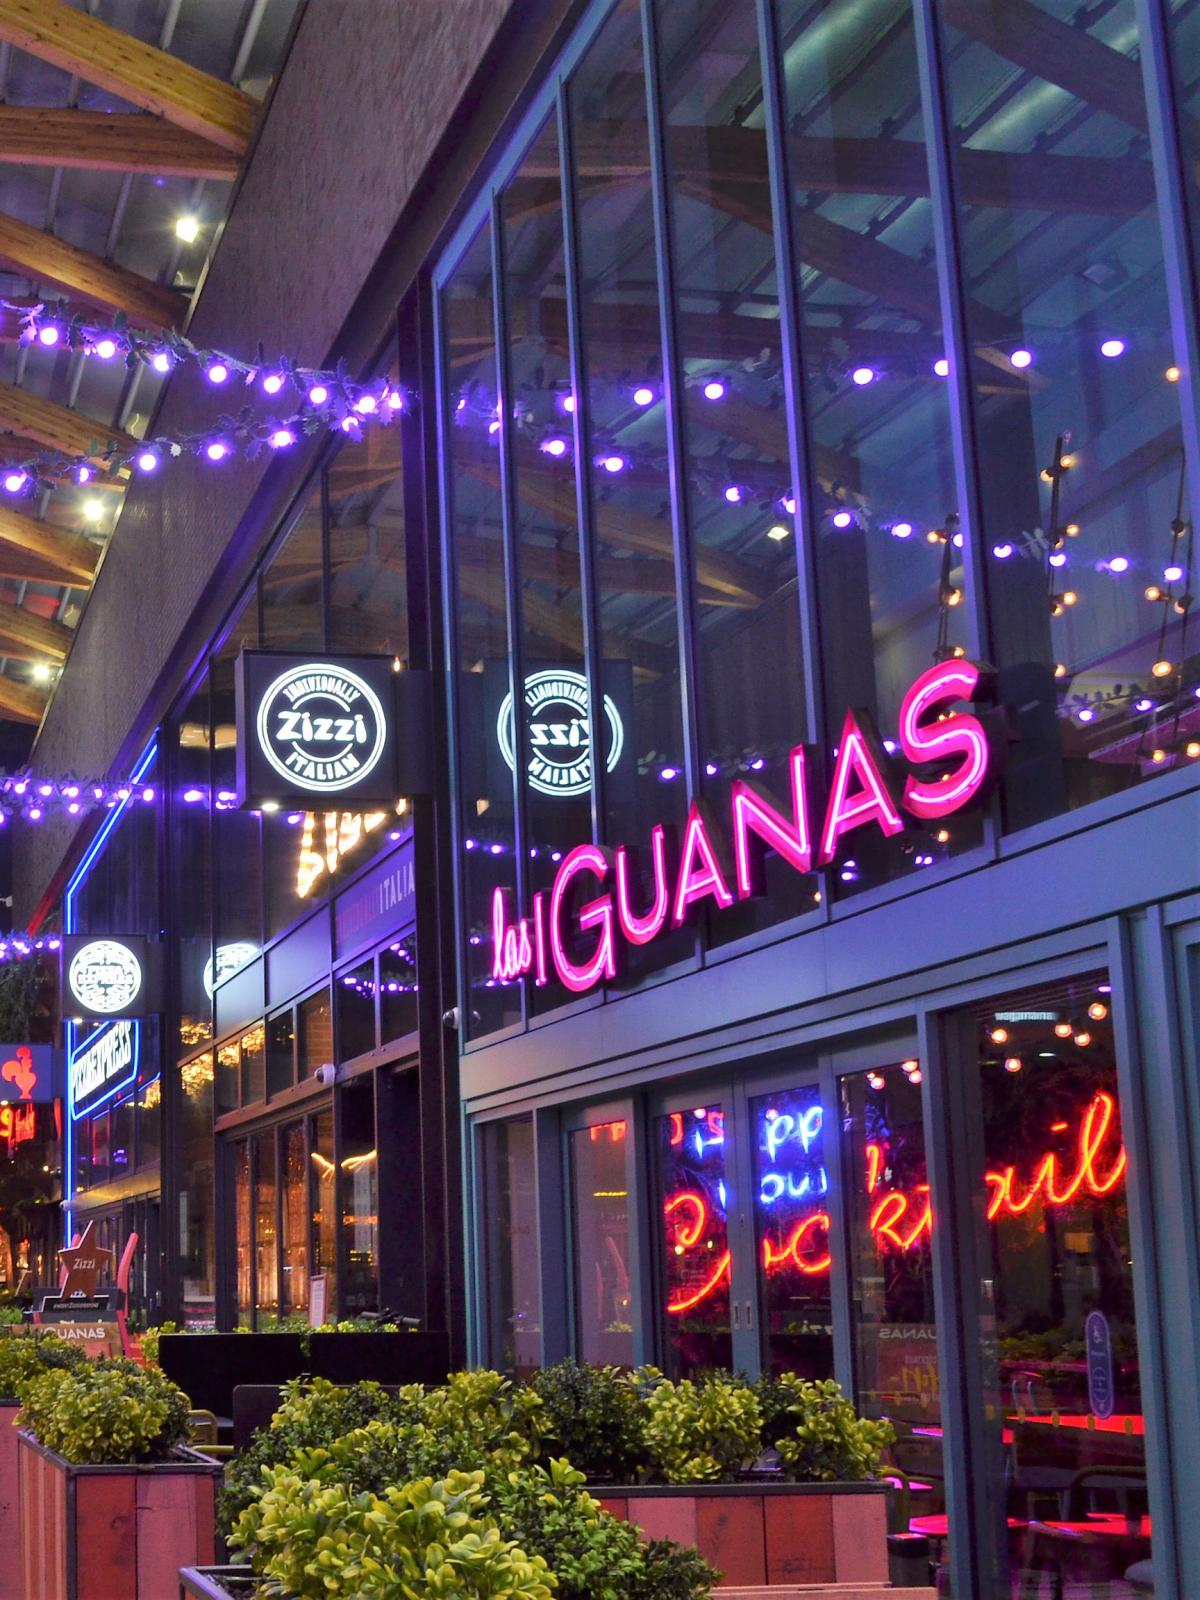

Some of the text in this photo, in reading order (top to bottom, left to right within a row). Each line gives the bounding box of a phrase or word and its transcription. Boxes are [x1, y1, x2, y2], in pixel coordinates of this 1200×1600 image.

[282, 675, 361, 703] INDIVIDUALLY
[275, 710, 367, 744] Zizzi
[284, 751, 360, 780] ITALIAN
[492, 886, 532, 981] las
[534, 658, 989, 992] IGUANAS
[379, 861, 415, 914] ITALIA
[72, 1258, 97, 1270] Zizzi
[41, 1327, 106, 1339] GUANAS
